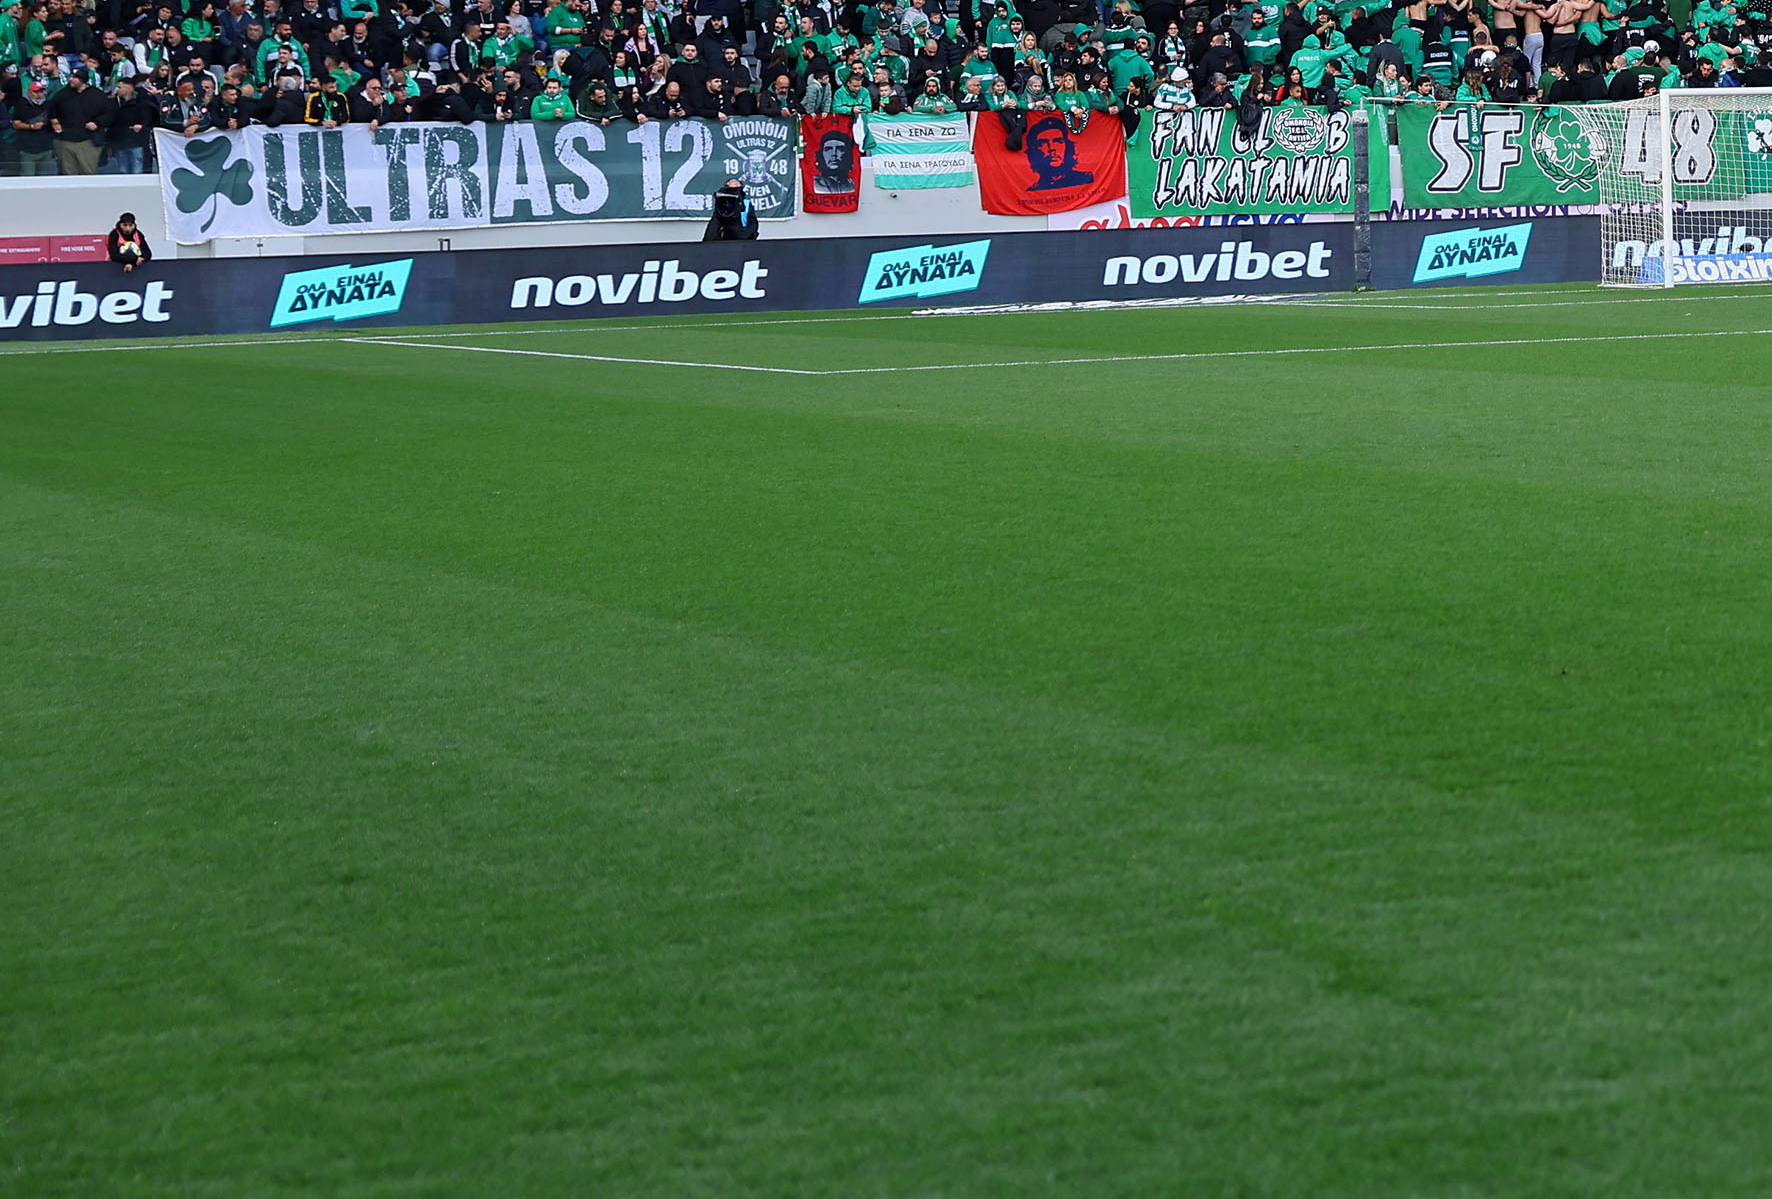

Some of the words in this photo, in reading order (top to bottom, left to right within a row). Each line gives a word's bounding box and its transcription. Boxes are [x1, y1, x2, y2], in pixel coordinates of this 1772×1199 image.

[722, 120, 788, 142] OMONOIA
[736, 137, 766, 149] ULTRAS
[766, 139, 775, 149] 12
[886, 128, 902, 138] ΓΙΑ
[908, 127, 935, 137] ΣΕΝΑ
[941, 127, 956, 136] ΖΩ
[1152, 107, 1225, 159] FAN
[1428, 109, 1524, 192] SF
[1619, 107, 1718, 185] 48
[262, 120, 610, 227] ULTRAS
[627, 119, 715, 211] 12
[723, 158, 739, 174] 19
[769, 158, 788, 175] 48
[883, 161, 896, 169] ΓΙΑ
[900, 161, 921, 169] ΣΕΝΑ
[1155, 155, 1352, 210] LAKATAMIA
[1428, 241, 1518, 270] ΔΥΝΑΤΑ
[1435, 243, 1460, 253] ΟΛΑ
[1469, 233, 1507, 246] ΕΙΝΑΙ
[875, 260, 974, 289] ΔΥΝΑΤΑ
[883, 260, 911, 271] ΟΛΑ
[920, 251, 964, 264] ΕΙΝΑΙ
[1103, 241, 1332, 286] novibet
[290, 279, 396, 312] ΔΥΝΑΤΑ
[295, 283, 326, 295] ΟΛΑ
[337, 271, 384, 286] ΕΙΝΑΙ
[510, 260, 769, 309] novibet
